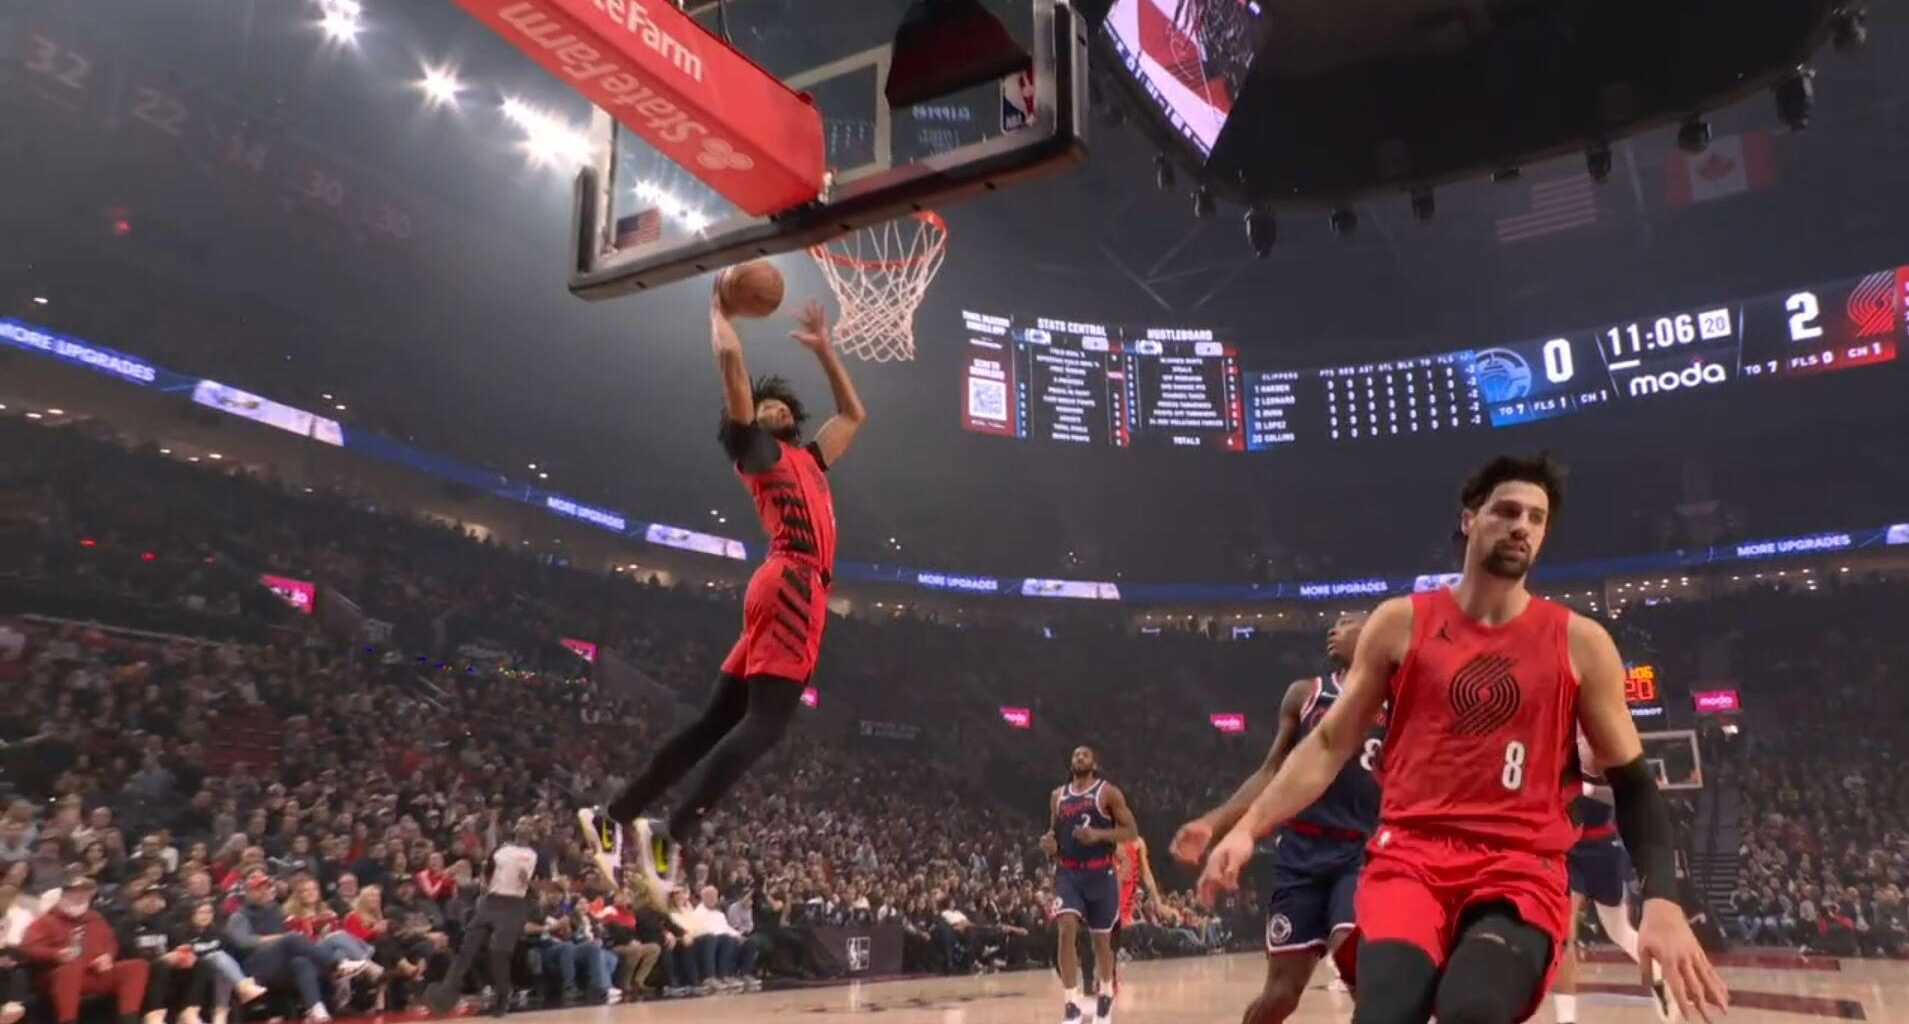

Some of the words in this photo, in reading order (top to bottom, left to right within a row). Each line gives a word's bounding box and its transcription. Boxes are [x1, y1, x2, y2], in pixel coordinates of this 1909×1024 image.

[25, 34, 91, 90] 32
[132, 86, 188, 136] 22
[1786, 291, 1824, 341] 2
[1607, 314, 1695, 357] 11:06
[1704, 316, 1726, 333] 20
[55, 339, 156, 382] UPGRADES
[1262, 372, 1298, 381] CLIPPERS
[1437, 355, 1455, 365] FLS
[1543, 338, 1574, 383] 0
[1744, 364, 1762, 375] TO
[1767, 360, 1778, 373] 7
[1791, 354, 1819, 368] FLS
[1822, 350, 1834, 364] 0
[1848, 346, 1869, 359] CH
[1872, 342, 1882, 356] 1
[1630, 361, 1726, 396] moda
[1498, 406, 1514, 416] TO
[1516, 404, 1525, 415] 7
[1534, 399, 1556, 411] FLS
[1560, 396, 1567, 408] 1
[1580, 392, 1597, 404] CH
[1600, 390, 1607, 401] 1
[1737, 543, 1776, 557] MORE
[1777, 534, 1851, 552] UPGRADES
[918, 573, 945, 587] MORE
[947, 578, 998, 591] UPGRADES
[1300, 585, 1330, 597] MORE
[1332, 580, 1388, 595] UPGRADES
[1699, 693, 1733, 708] moda
[1501, 740, 1526, 790] 8
